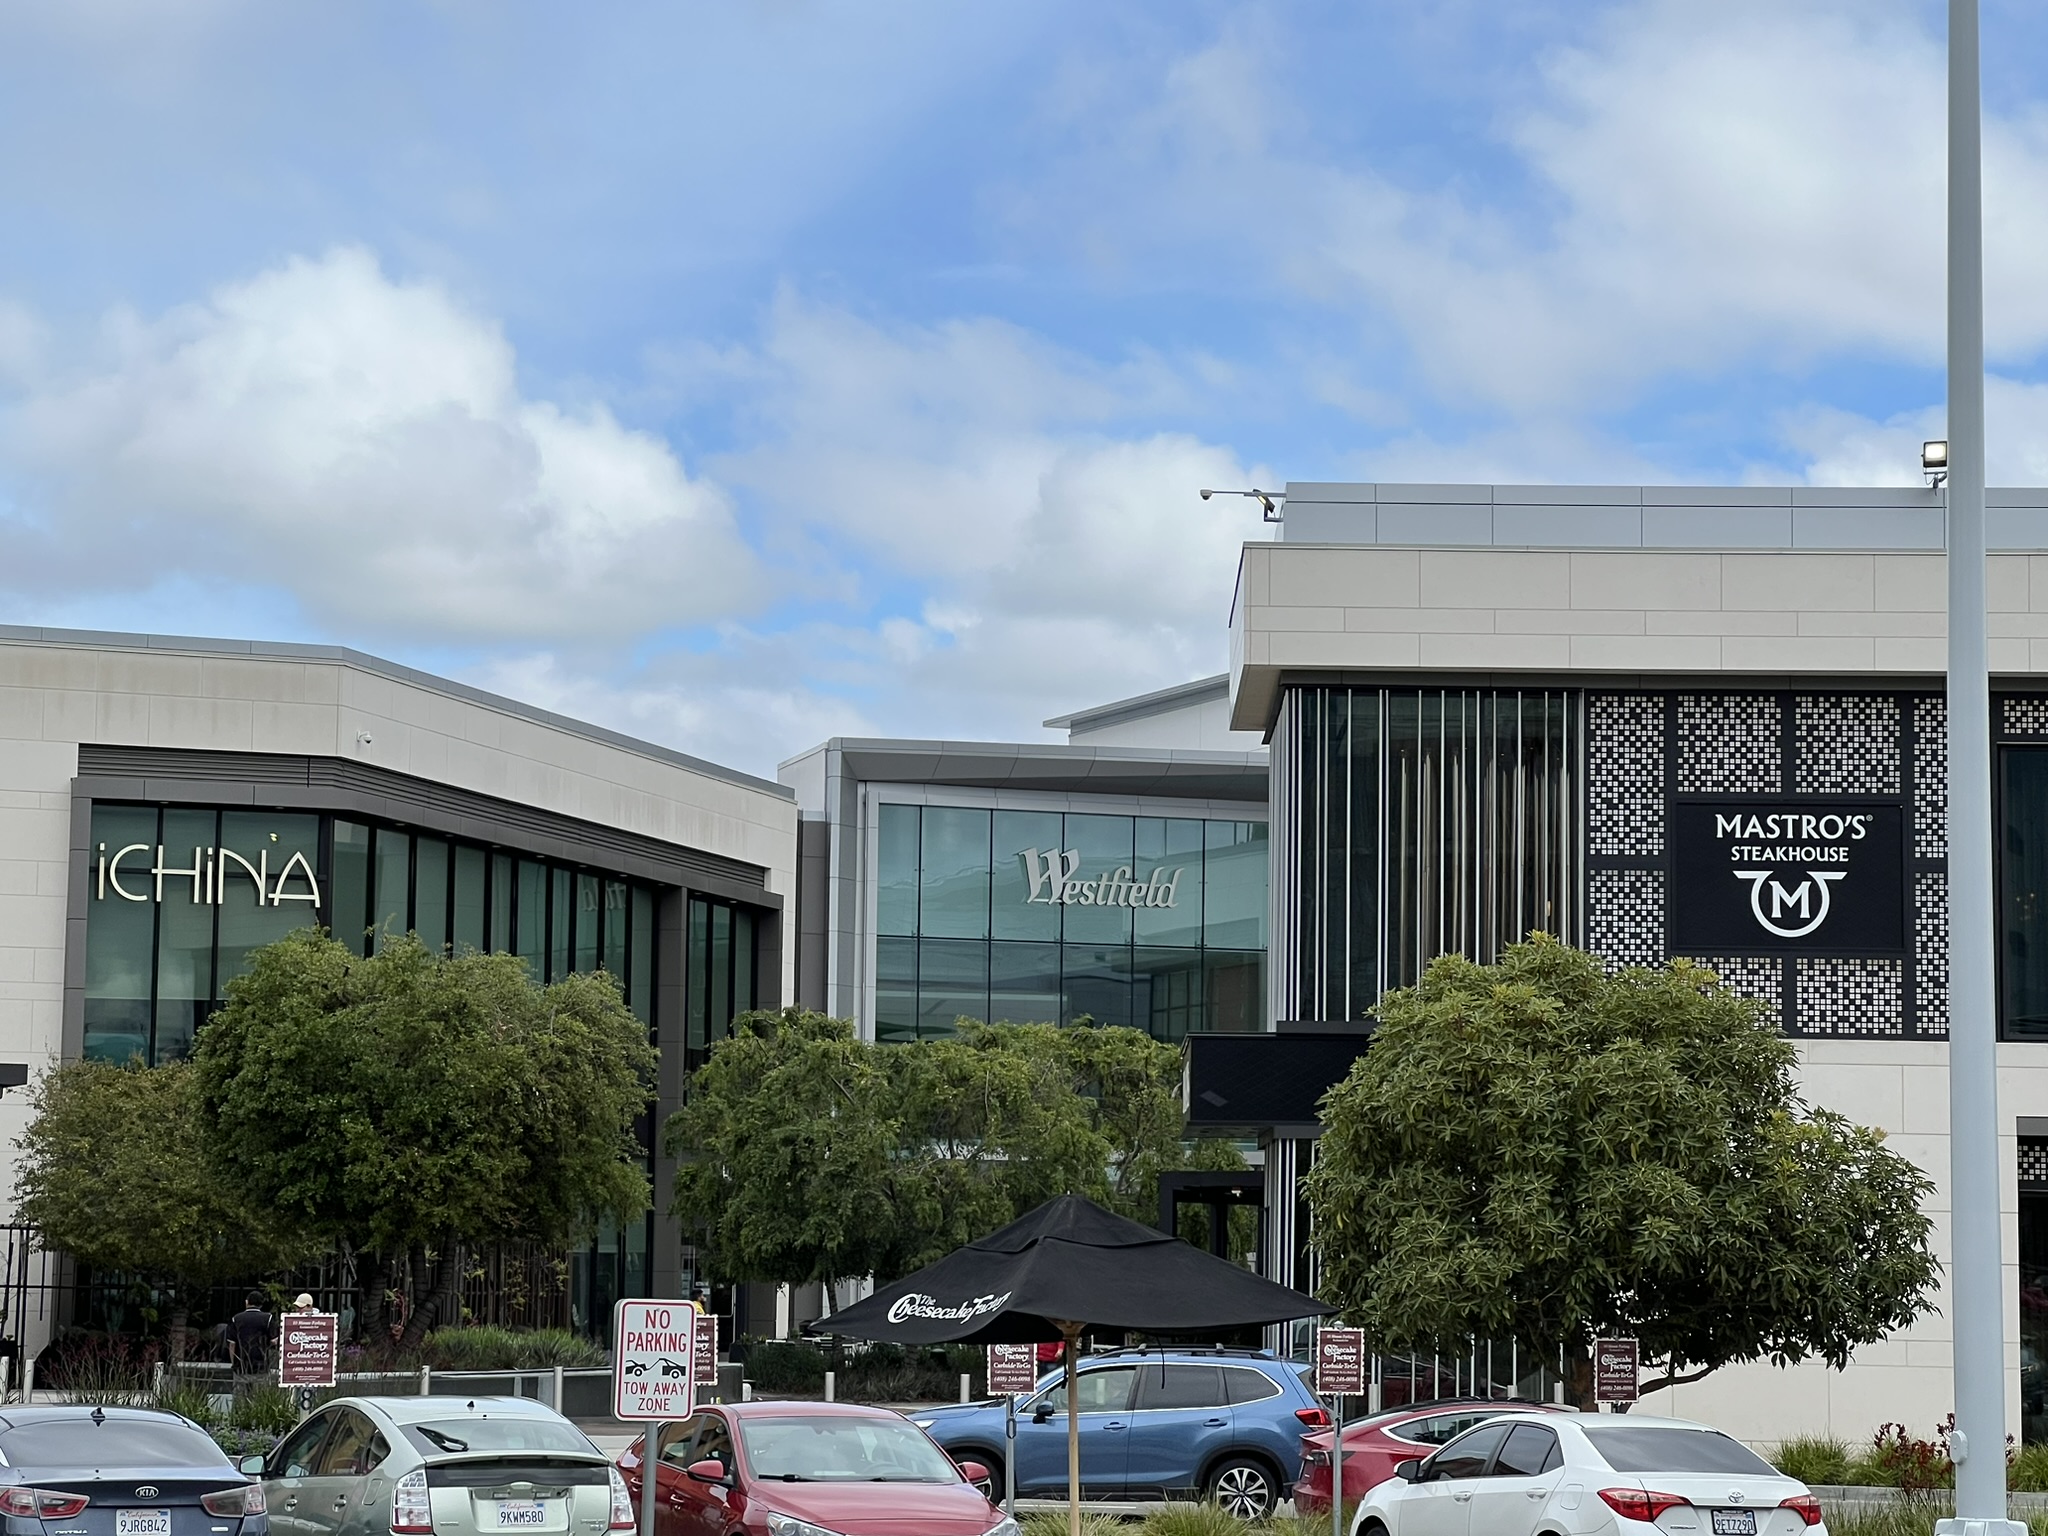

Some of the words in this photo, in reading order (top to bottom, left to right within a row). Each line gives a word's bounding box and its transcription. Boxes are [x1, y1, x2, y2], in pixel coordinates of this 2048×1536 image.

[1731, 846, 1849, 862] STEAKHOUSE
[1017, 847, 1185, 908] Westfield
[920, 1294, 937, 1306] The
[887, 1293, 972, 1324] Cheesecake
[645, 1308, 671, 1330] NO
[300, 1342, 328, 1351] Factory
[626, 1331, 687, 1352] PARKING
[624, 1381, 648, 1396] TOW
[653, 1382, 687, 1396] AWAY
[638, 1397, 671, 1411] ZONE
[139, 1488, 155, 1496] KIA
[506, 1502, 535, 1511] California
[127, 1510, 160, 1519] California
[500, 1510, 544, 1524] 9KWM580
[120, 1519, 167, 1533] 9JRG842
